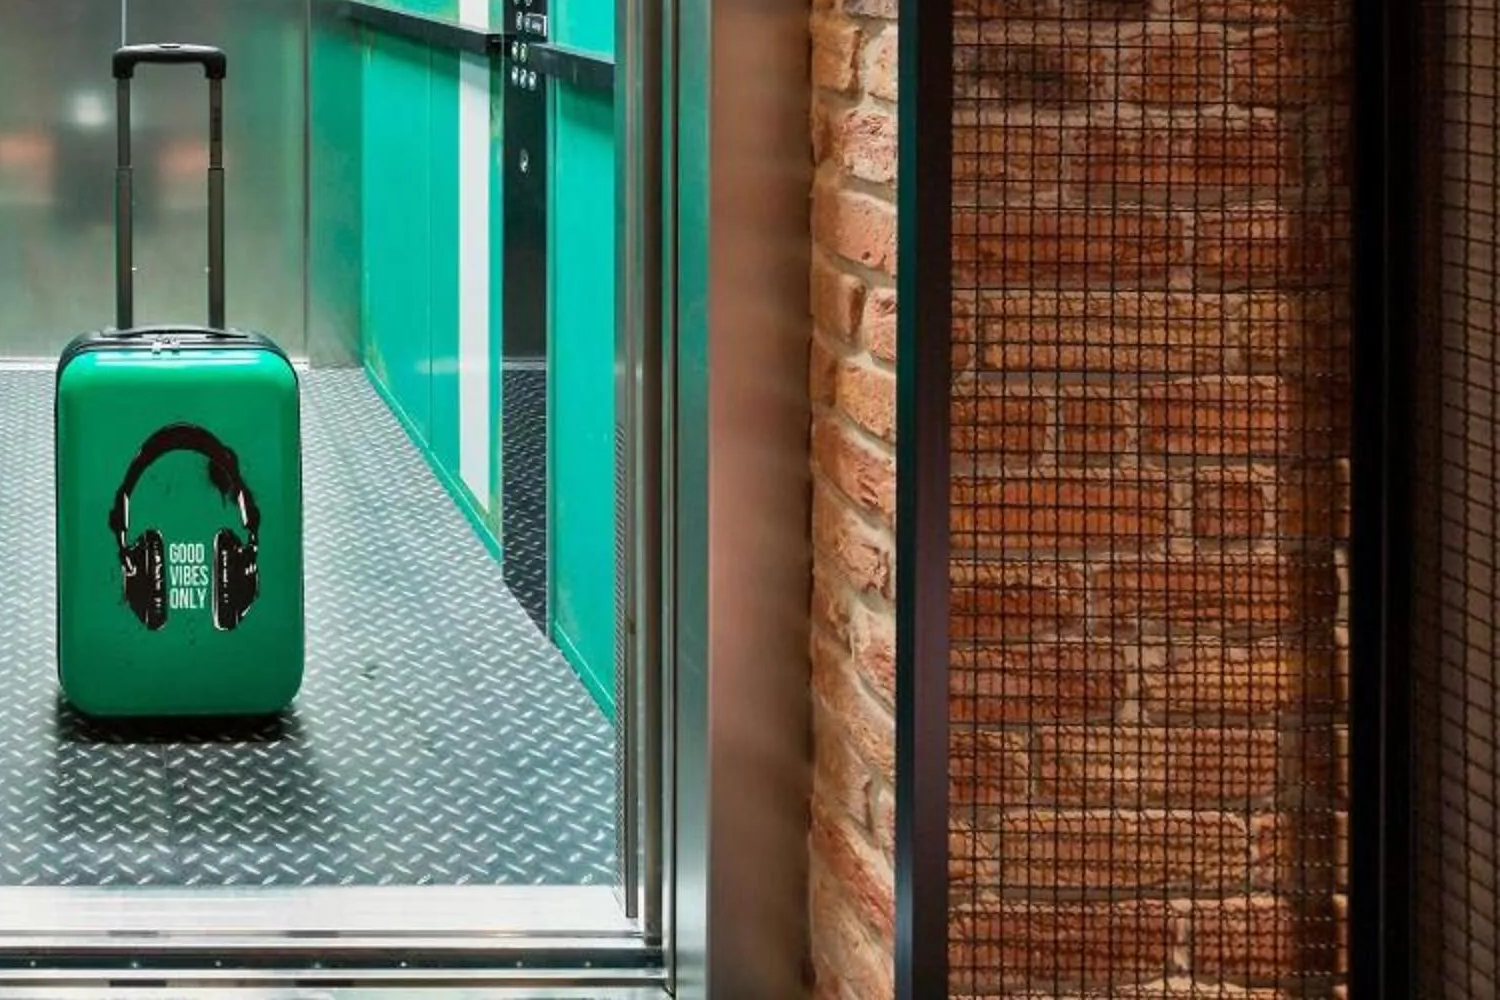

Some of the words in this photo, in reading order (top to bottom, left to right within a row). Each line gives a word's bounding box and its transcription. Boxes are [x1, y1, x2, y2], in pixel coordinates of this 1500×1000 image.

[169, 543, 205, 564] GOOD
[169, 565, 209, 586] VIBES
[169, 587, 207, 609] ONLY
